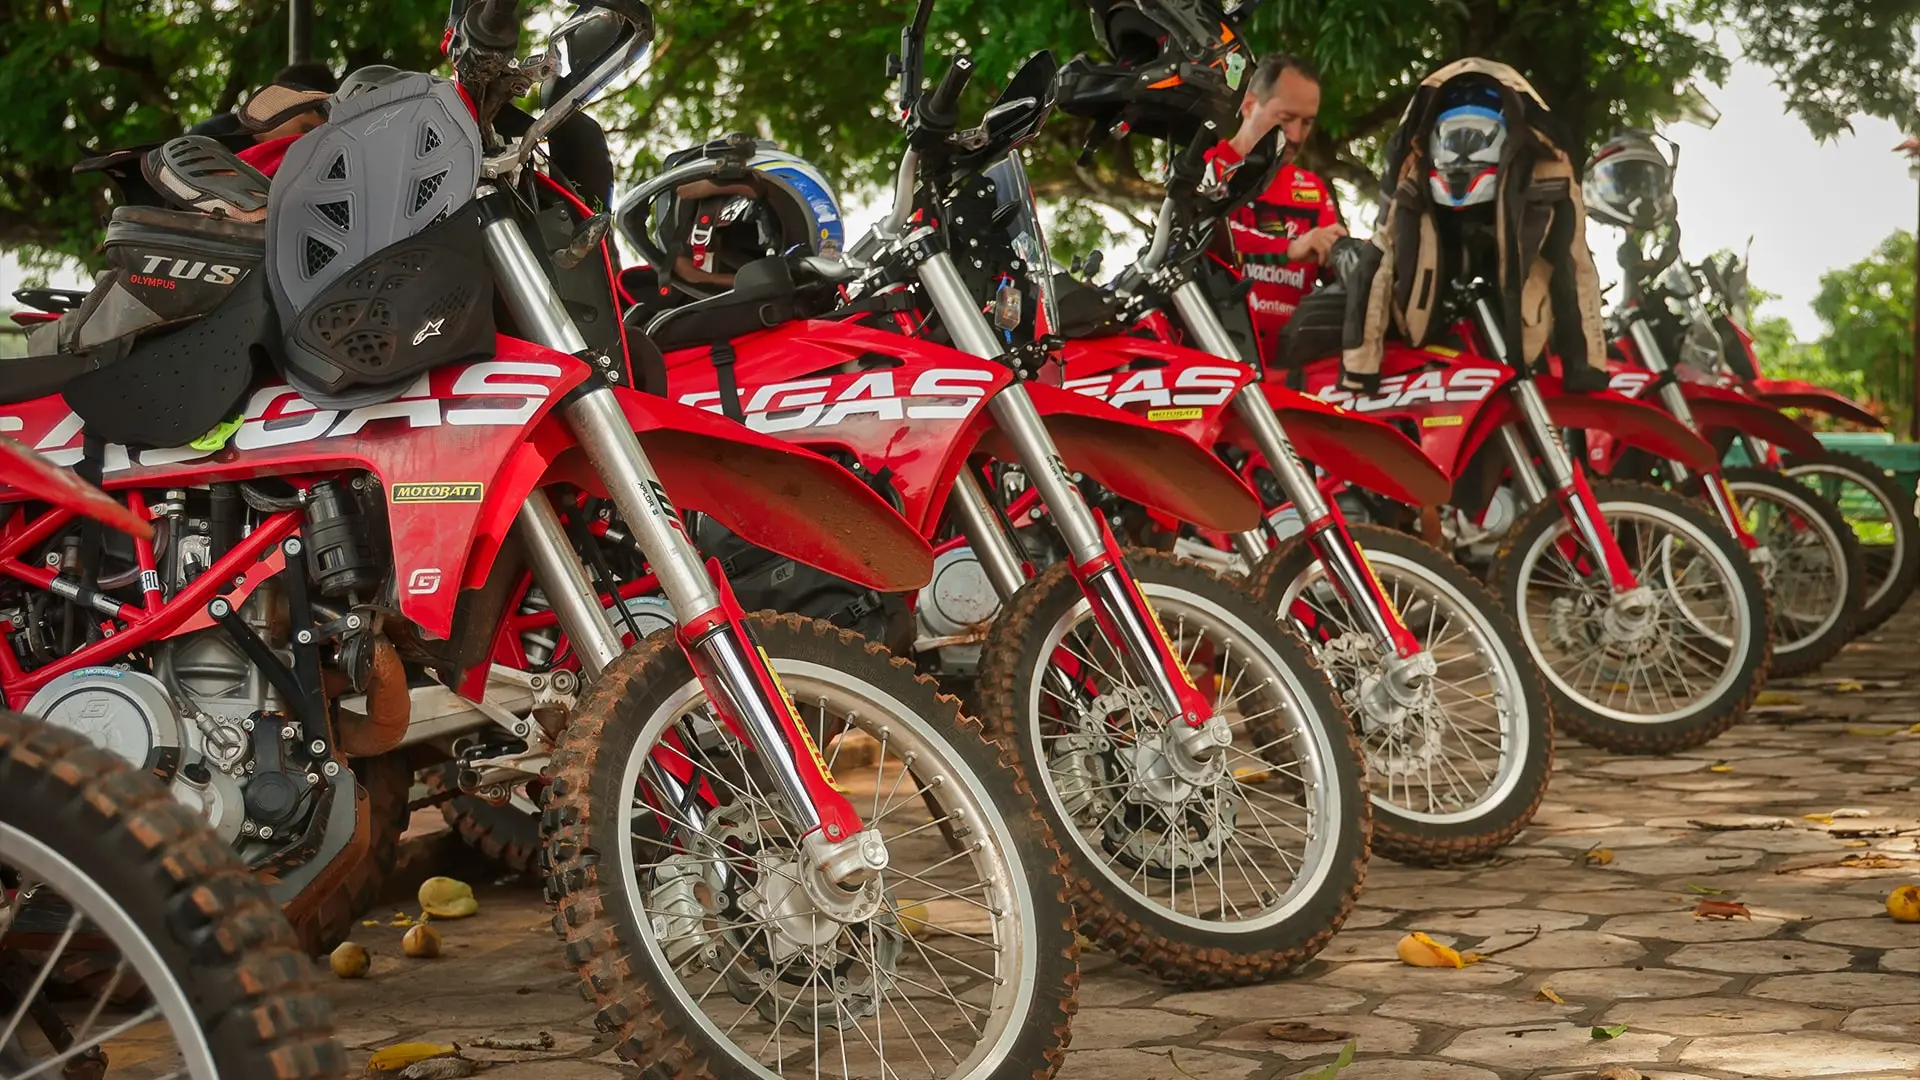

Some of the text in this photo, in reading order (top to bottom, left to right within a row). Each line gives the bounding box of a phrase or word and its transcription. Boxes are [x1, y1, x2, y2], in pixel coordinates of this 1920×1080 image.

[142, 255, 250, 285] TUS
[130, 274, 176, 290] OLYMPUS
[396, 486, 479, 500] MOTOBATT
[637, 481, 655, 508] XPLOR
